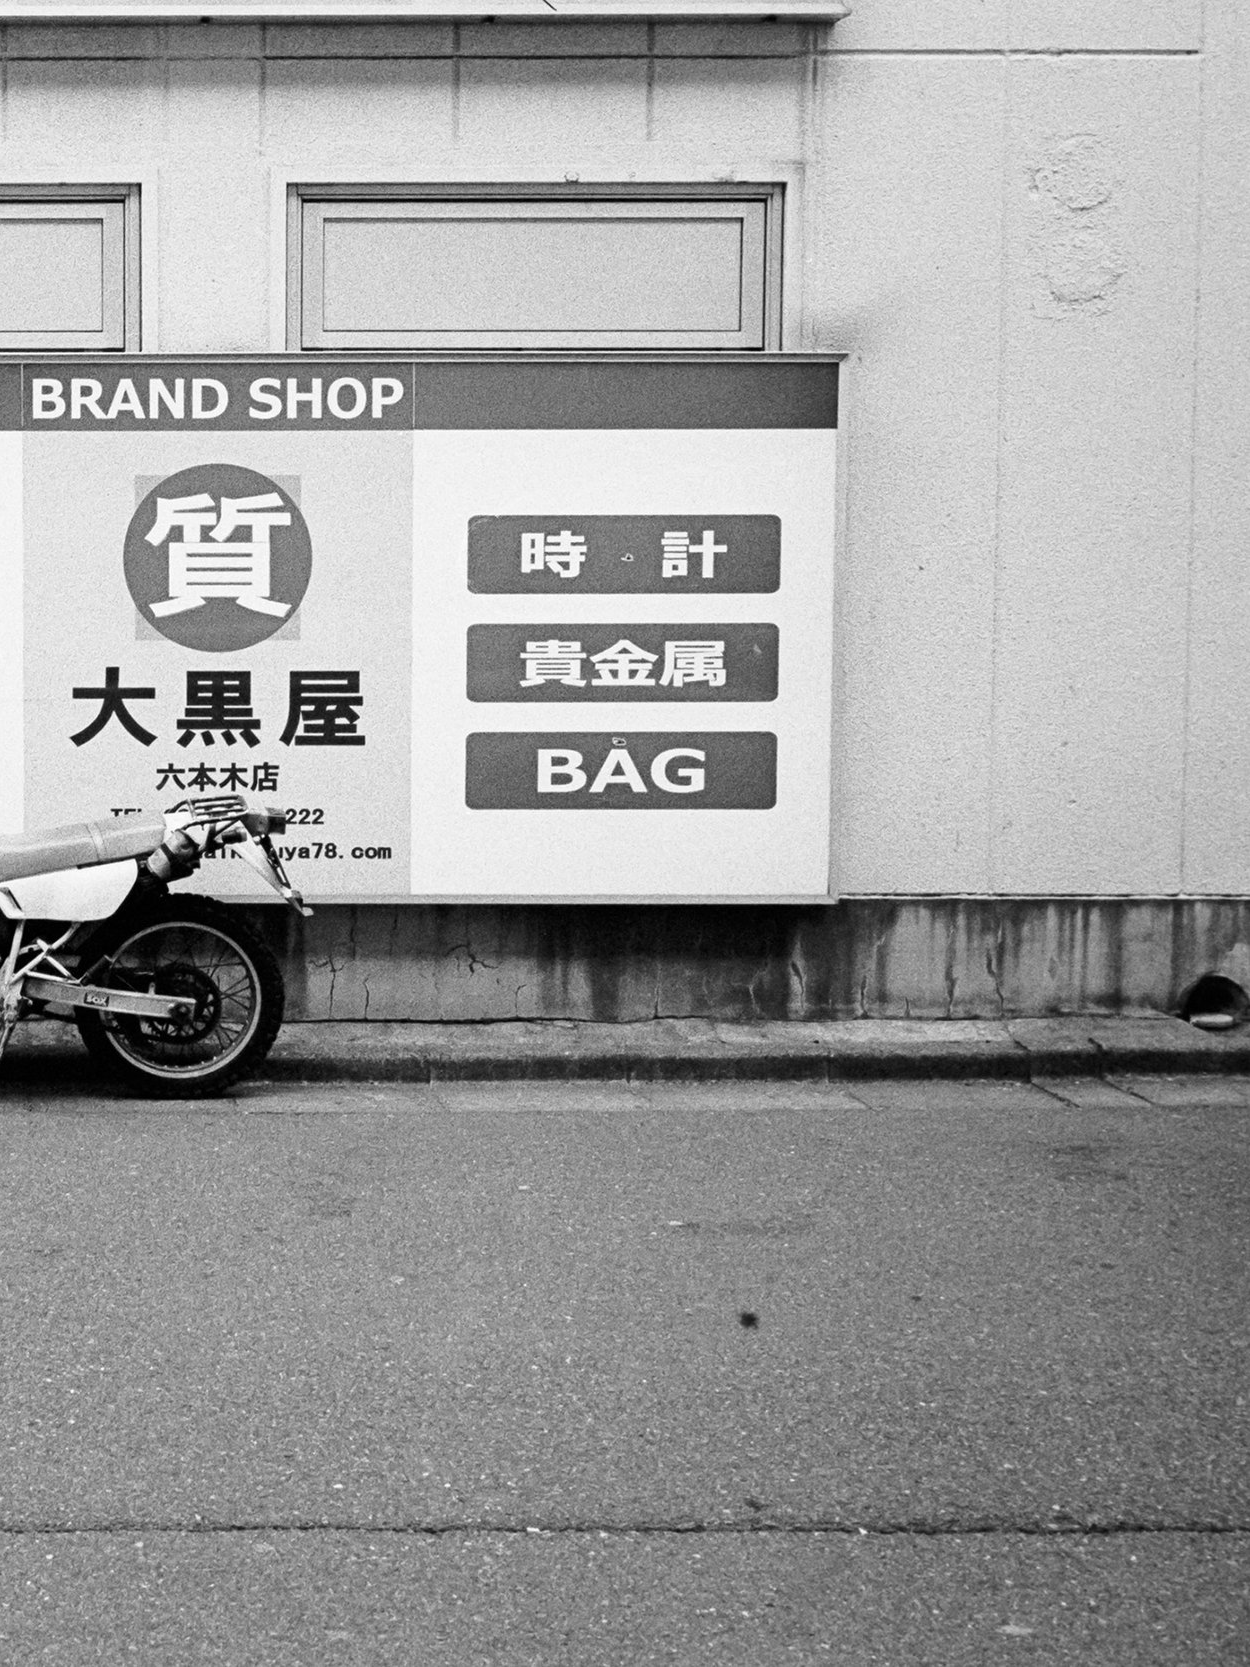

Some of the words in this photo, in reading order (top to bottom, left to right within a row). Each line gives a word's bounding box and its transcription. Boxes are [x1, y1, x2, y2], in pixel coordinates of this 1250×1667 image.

[32, 378, 229, 419] BRAND
[248, 377, 404, 420] SHOP
[144, 492, 292, 618] 質
[521, 530, 728, 578] 時計
[519, 639, 727, 687] 貴金属
[69, 666, 366, 748] 大黒屋
[156, 762, 280, 791] 六本木店
[537, 747, 706, 793] BAG
